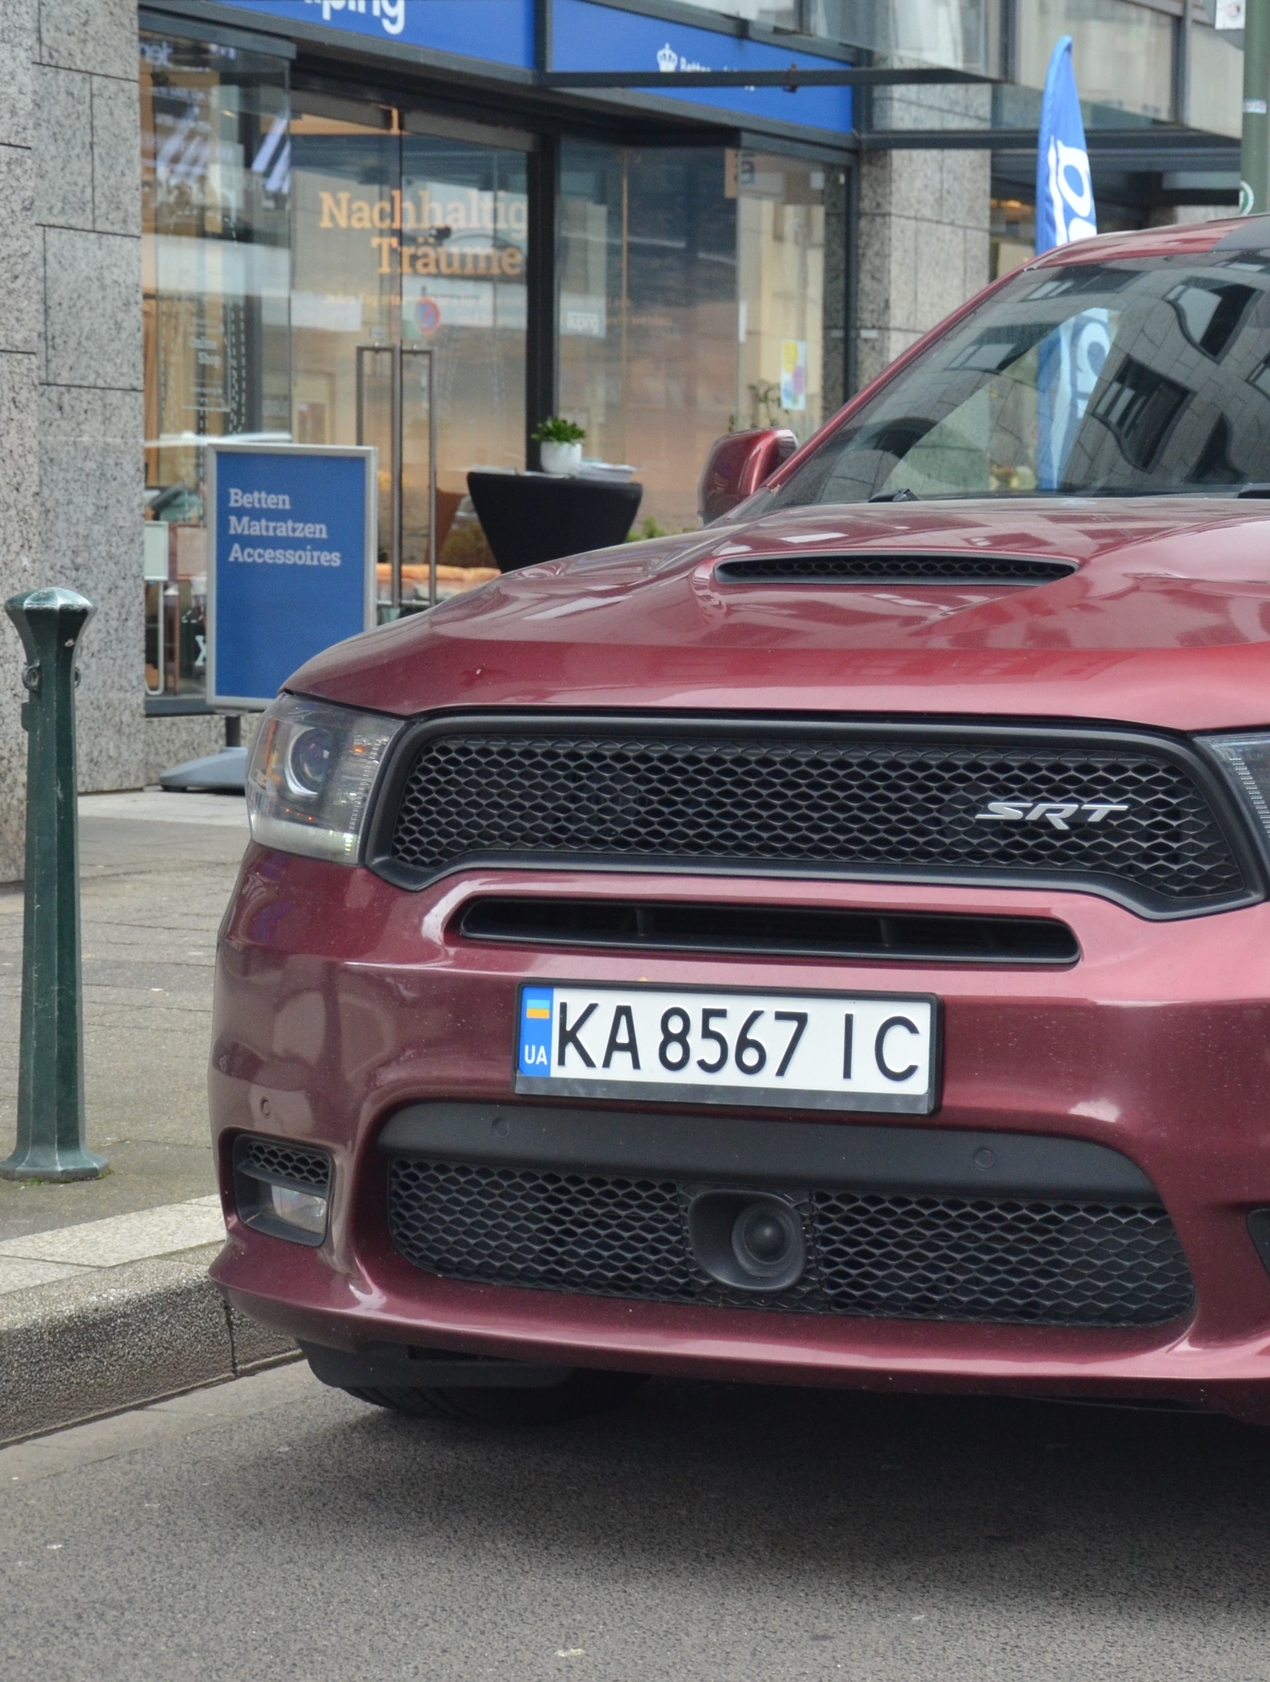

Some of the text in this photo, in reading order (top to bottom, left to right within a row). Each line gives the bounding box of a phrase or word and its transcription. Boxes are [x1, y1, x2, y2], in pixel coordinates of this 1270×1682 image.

[371, 235, 523, 276] Träume
[229, 488, 291, 510] Betten
[228, 515, 328, 539] Matratzen
[228, 542, 341, 567] Accessoires
[974, 802, 1129, 830] SRT
[557, 1001, 641, 1070] KA
[658, 1006, 808, 1078] 8567
[524, 1045, 548, 1066] UA
